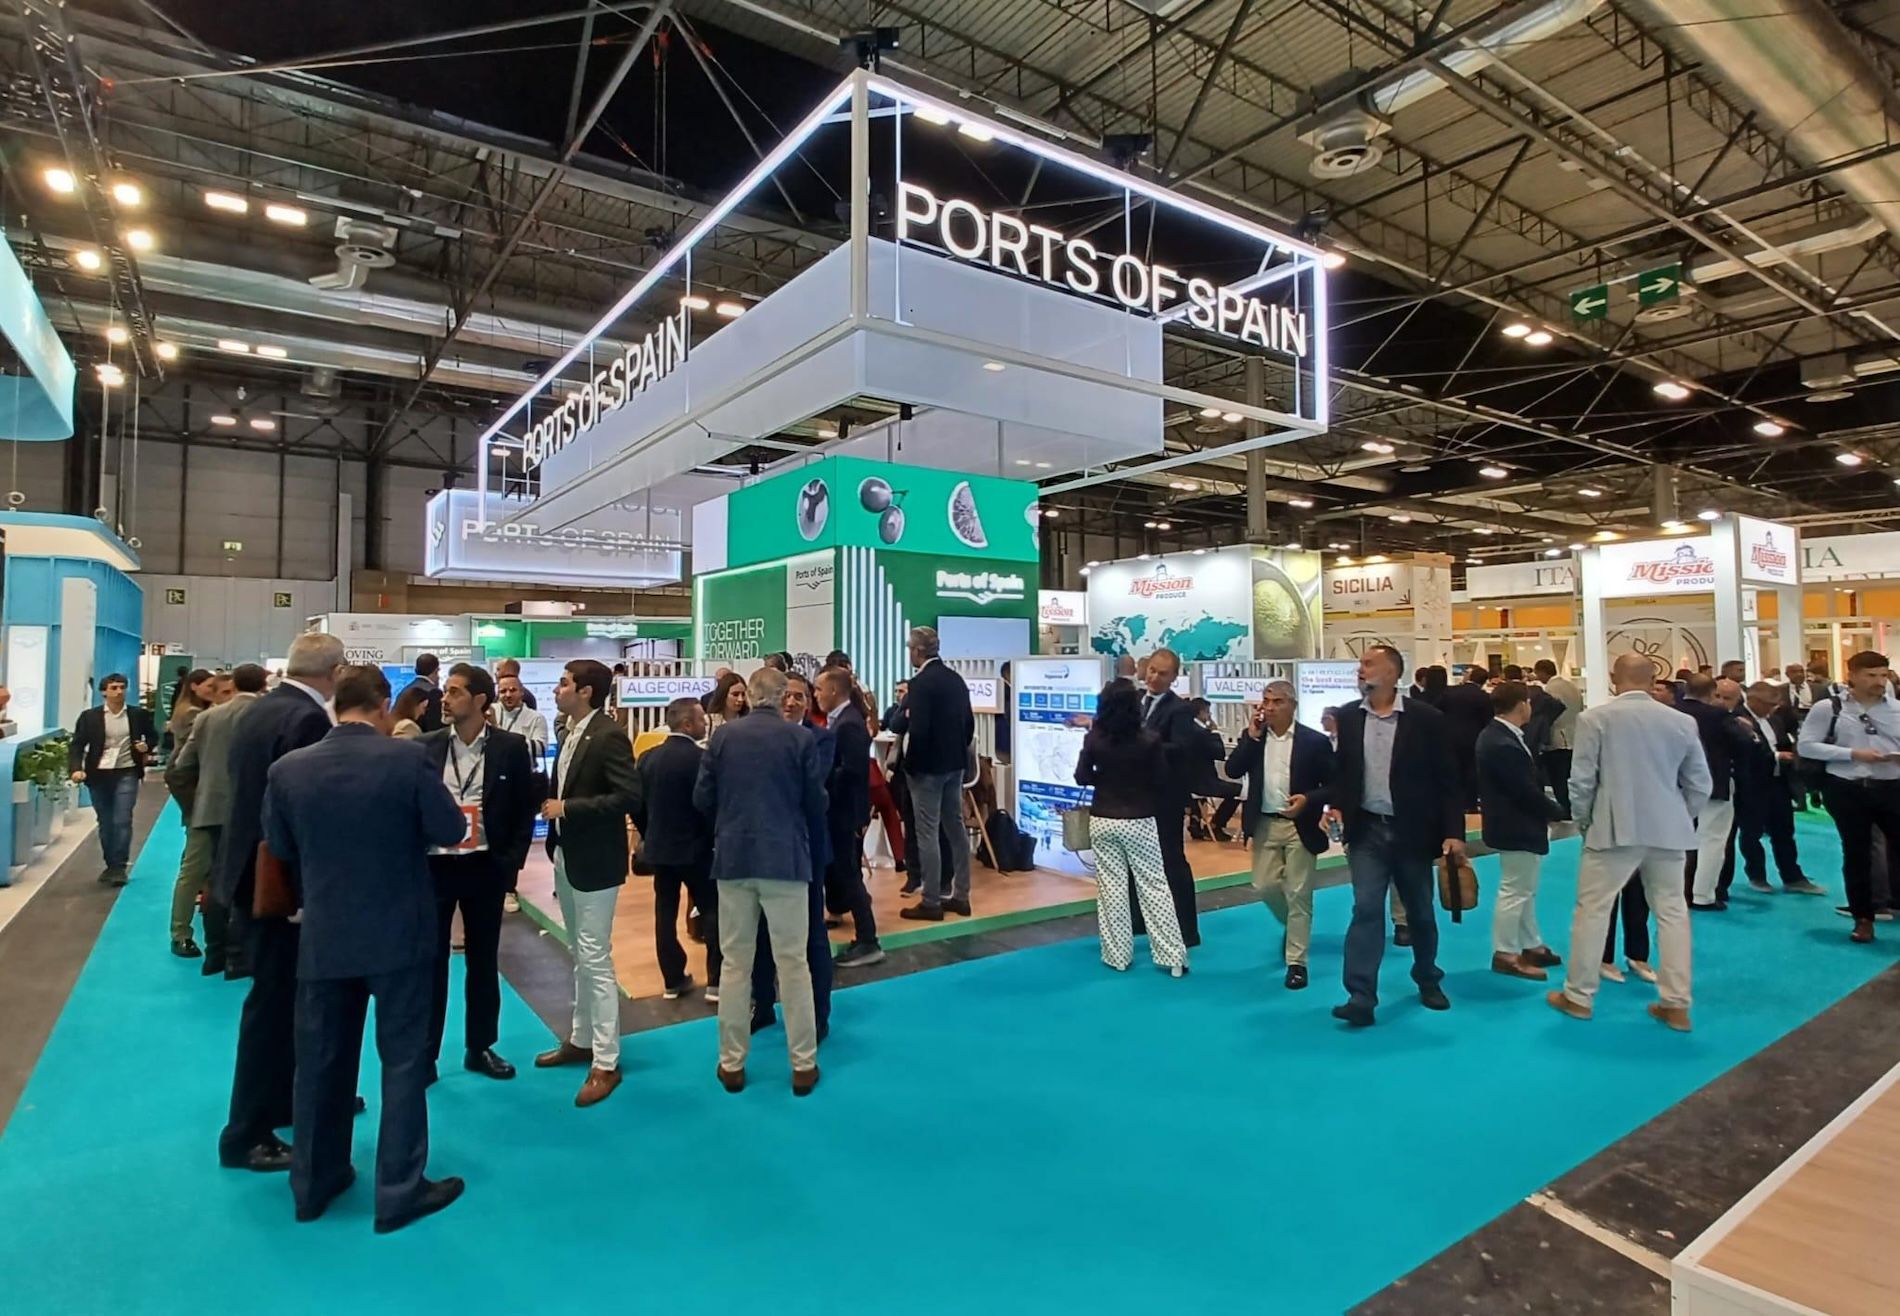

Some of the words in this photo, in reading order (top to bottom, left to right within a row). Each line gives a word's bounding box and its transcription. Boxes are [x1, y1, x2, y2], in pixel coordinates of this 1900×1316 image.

[897, 181, 1099, 295] PORTS
[1111, 253, 1177, 312] OF
[1187, 278, 1306, 357] SPAIN
[523, 399, 576, 473] PORTS
[579, 371, 607, 432] OF
[610, 302, 688, 410] SPAIN
[1803, 547, 1843, 568] IA
[936, 571, 972, 588] Ports
[973, 571, 988, 588] of
[989, 573, 1025, 592] Spain
[1534, 566, 1574, 586] ITA
[1630, 561, 1714, 584] Missio
[1676, 577, 1714, 585] PRODU
[1129, 577, 1193, 598] Mission
[1332, 576, 1393, 595] SICILIA
[704, 618, 765, 641] TOGETHER
[346, 650, 383, 660] OVING
[704, 640, 760, 659] FORWARD
[627, 680, 711, 694] ALGECIRAS
[969, 681, 993, 697] RAS
[1214, 681, 1265, 692] VALENCI
